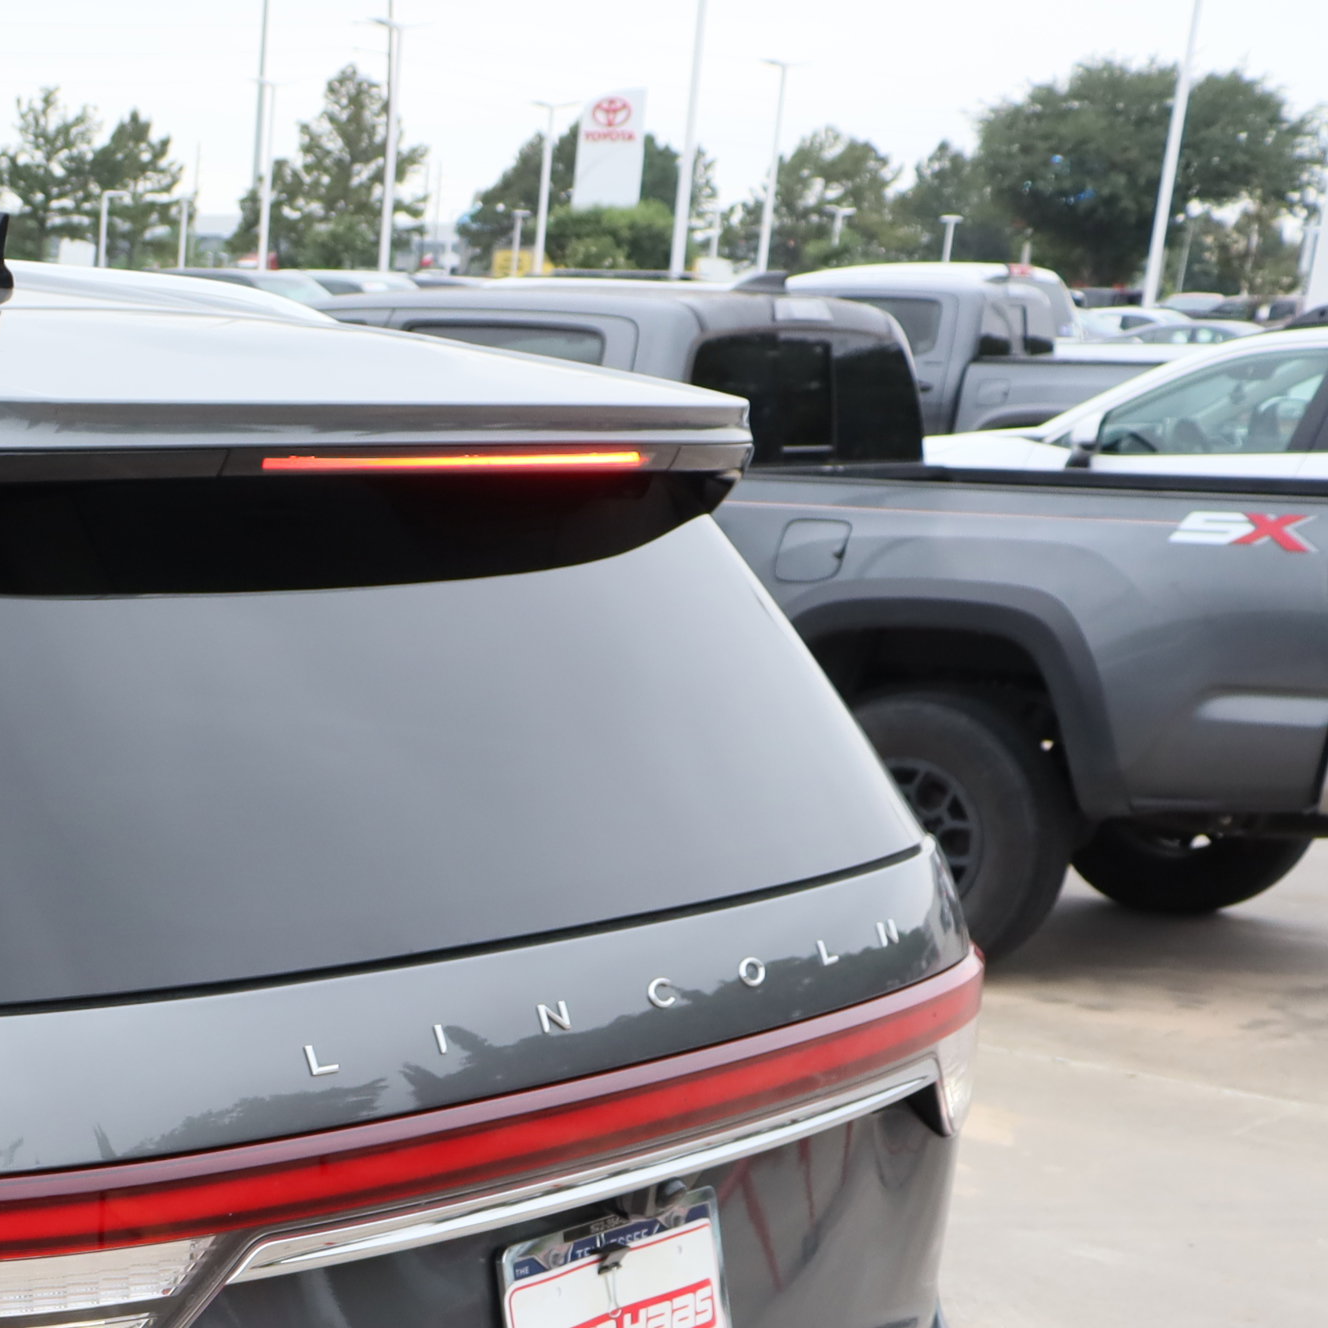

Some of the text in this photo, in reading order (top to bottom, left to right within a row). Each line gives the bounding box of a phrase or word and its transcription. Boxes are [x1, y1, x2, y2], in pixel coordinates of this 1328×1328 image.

[583, 130, 636, 142] TOYOTA
[1168, 510, 1320, 553] SX
[304, 918, 901, 1076] LINCOLN
